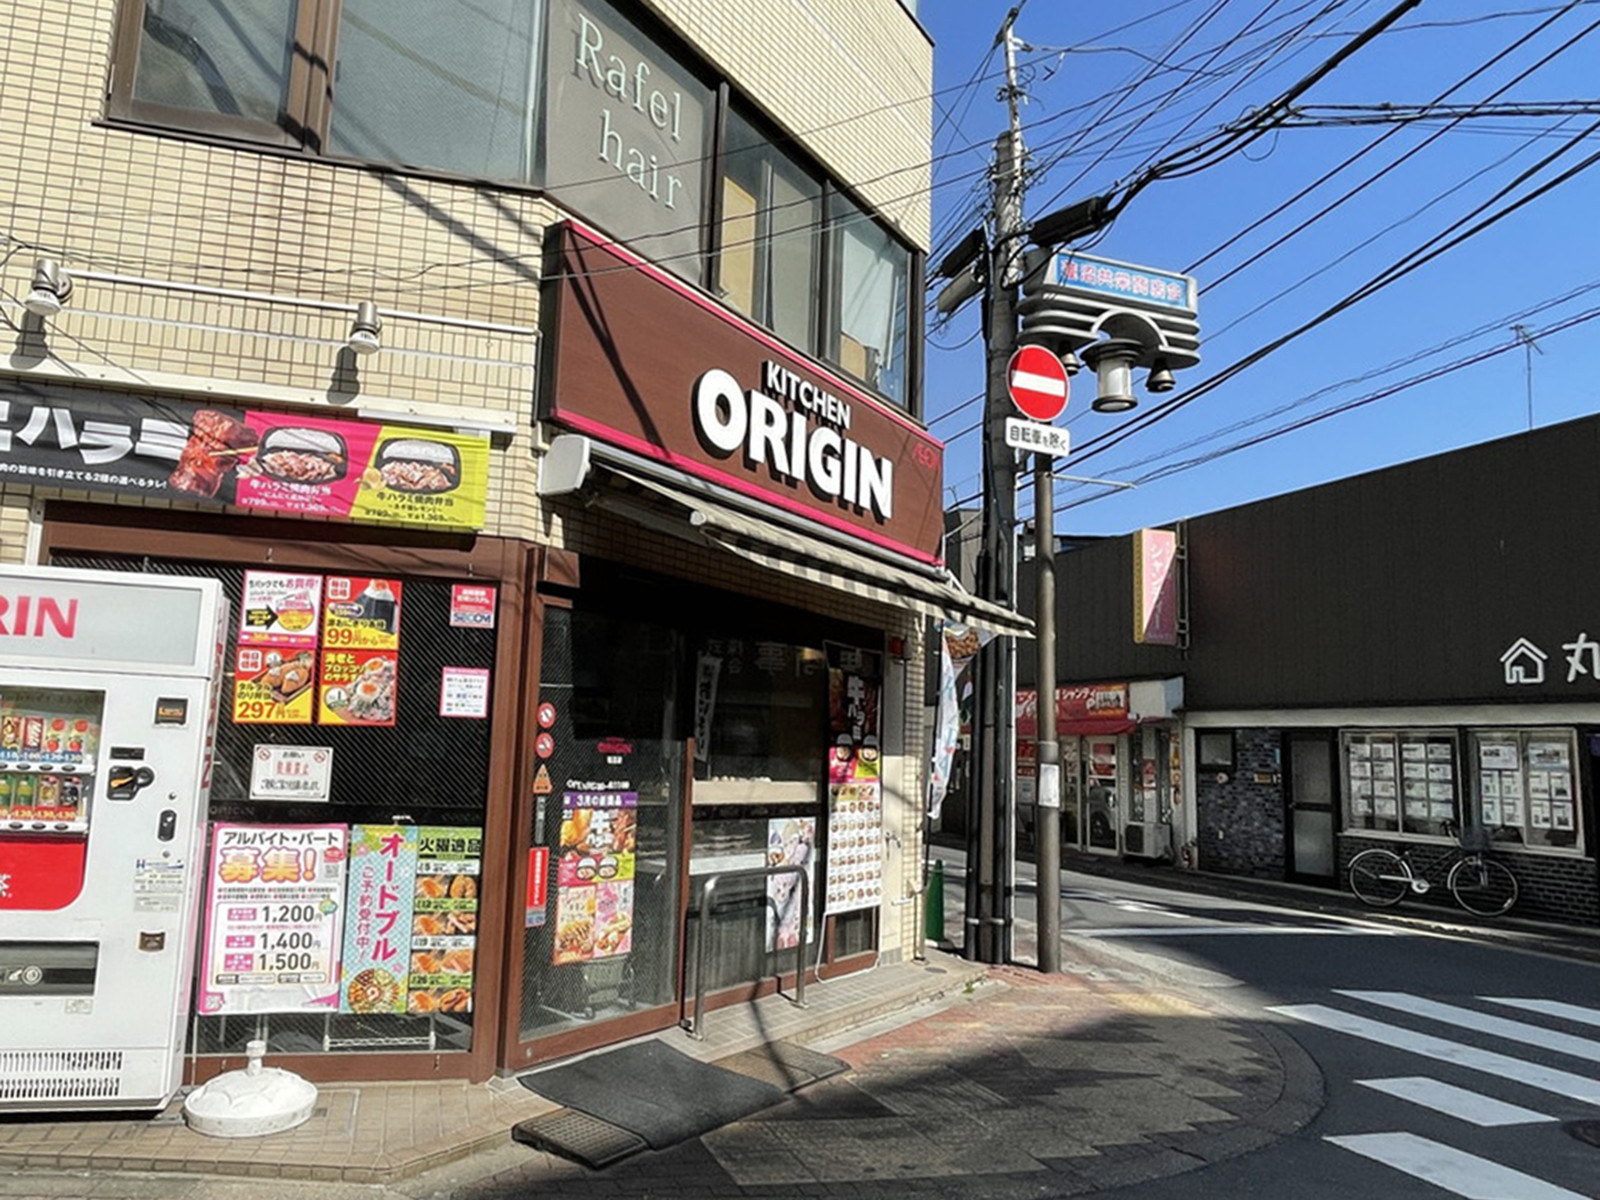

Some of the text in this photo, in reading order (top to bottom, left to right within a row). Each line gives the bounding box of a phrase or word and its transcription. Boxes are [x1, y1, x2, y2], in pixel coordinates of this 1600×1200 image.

[575, 12, 681, 141] Rafel
[599, 108, 682, 210] hair
[765, 359, 851, 430] KITCHEN
[695, 368, 893, 520] ORIGIN
[1009, 424, 1067, 451] 自転車を除く
[375, 491, 455, 508] 牛ハラミ焼肉弁当
[219, 846, 317, 883] 募集!
[224, 831, 339, 846] アルバイト・パート
[371, 833, 405, 961] オードブル
